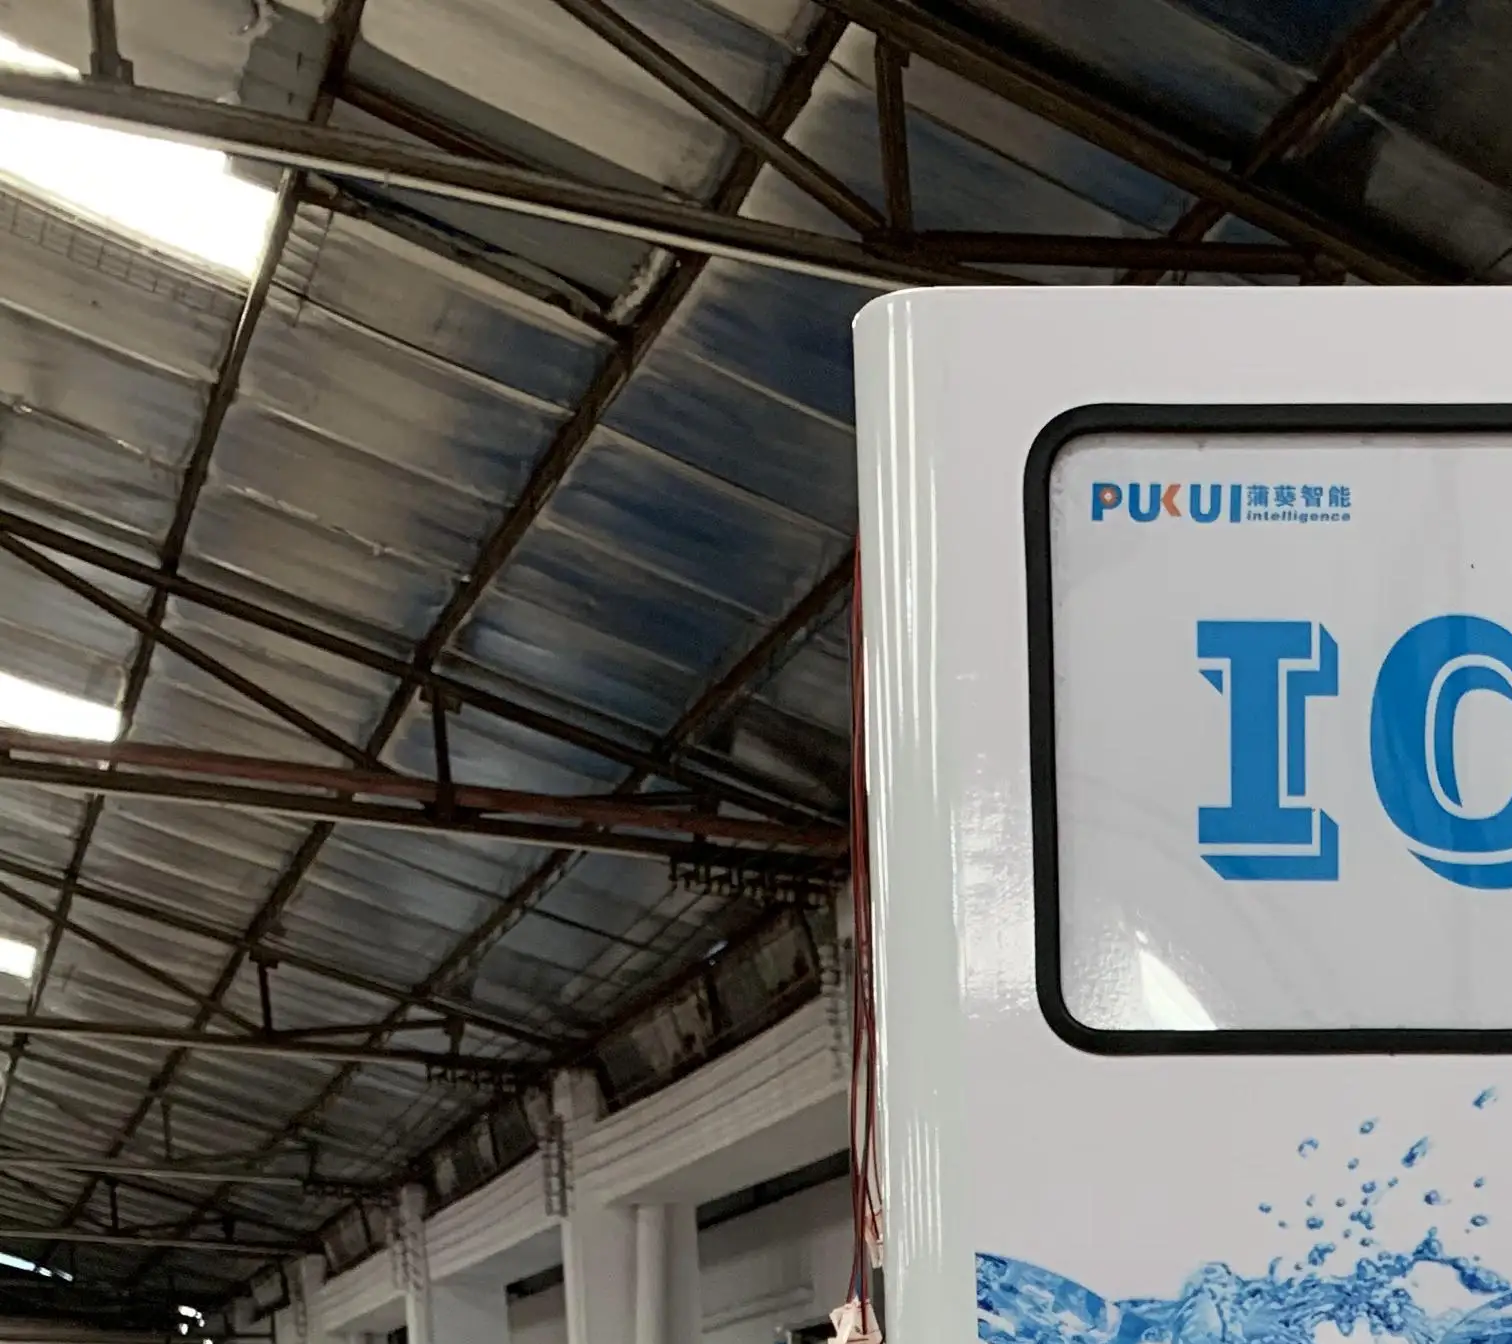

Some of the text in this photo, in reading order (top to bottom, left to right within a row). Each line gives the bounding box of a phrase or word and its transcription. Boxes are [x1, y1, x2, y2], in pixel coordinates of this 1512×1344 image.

[1091, 482, 1242, 523] PUKUI
[1246, 484, 1352, 508] 蒲葵智能
[1246, 510, 1351, 524] intelligence
